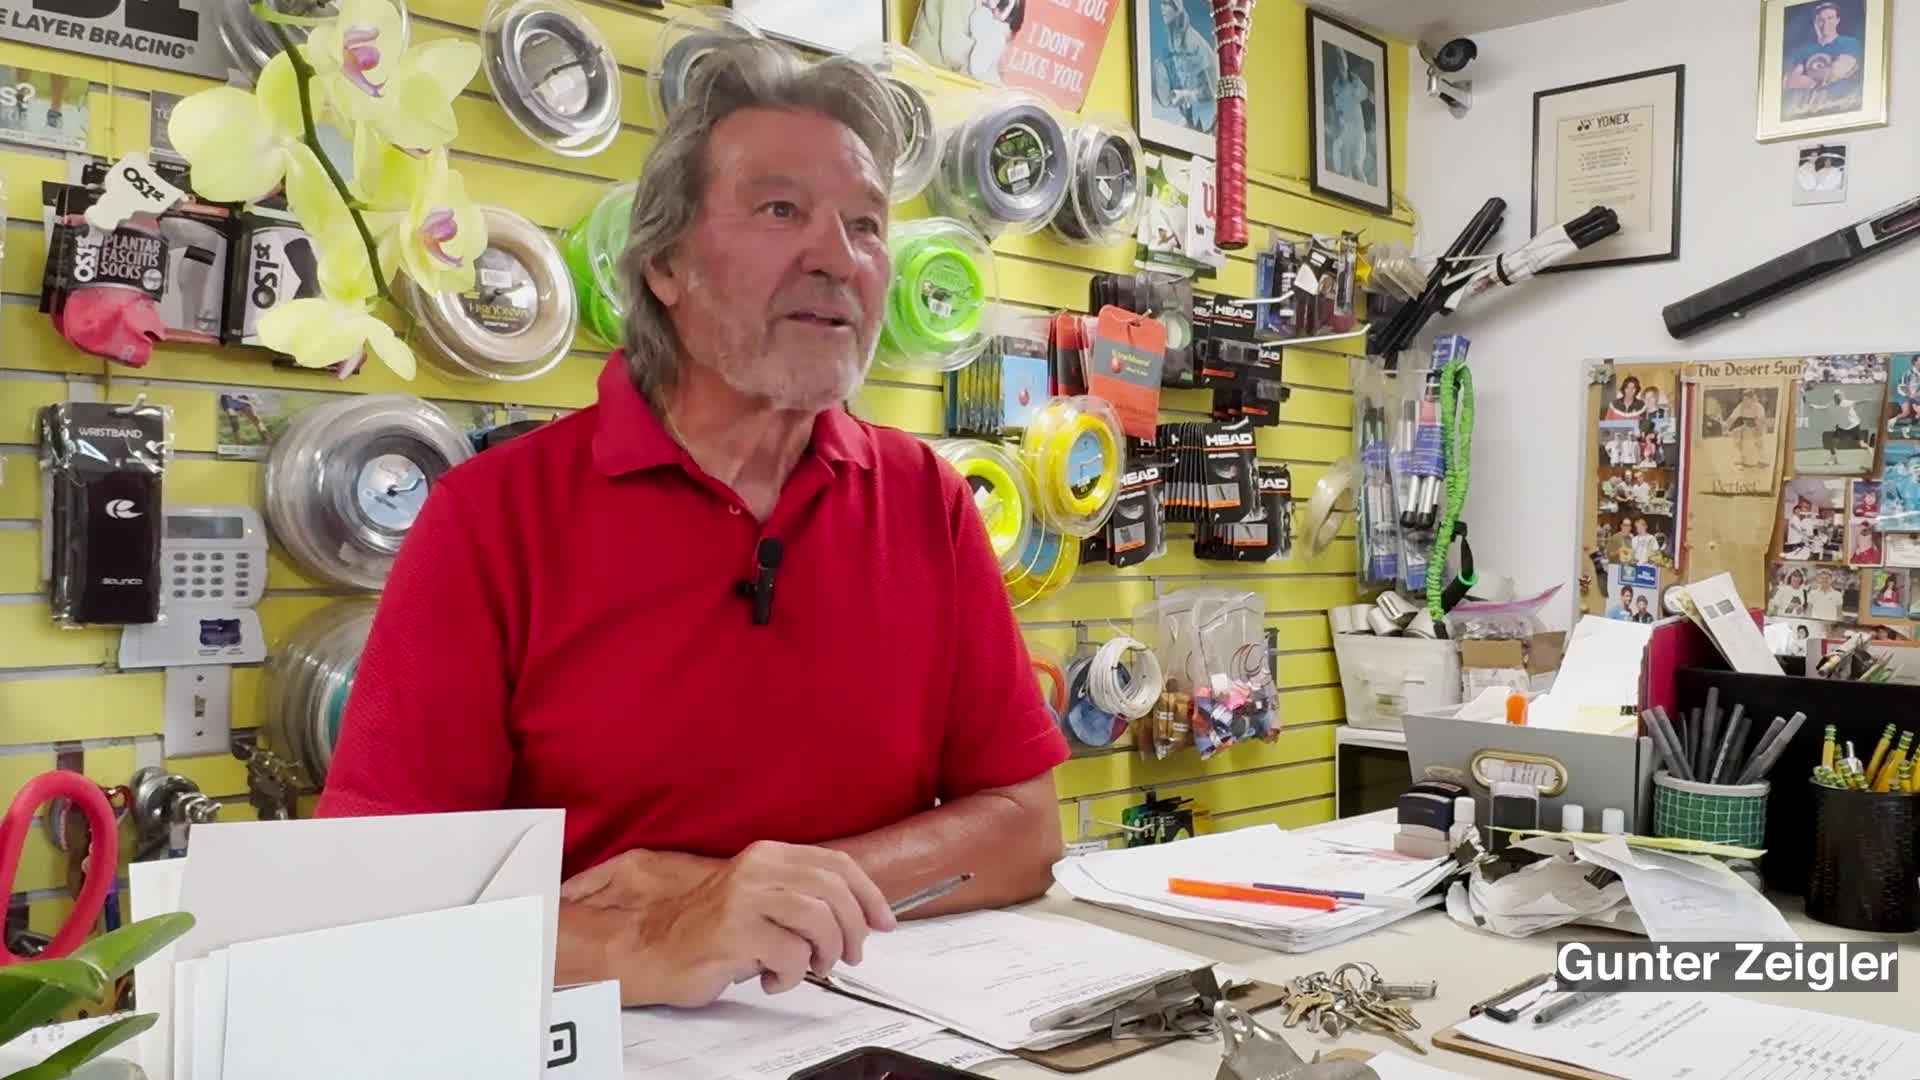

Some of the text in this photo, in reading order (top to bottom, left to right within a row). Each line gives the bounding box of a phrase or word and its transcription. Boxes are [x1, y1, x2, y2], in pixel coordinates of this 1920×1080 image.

[12, 11, 85, 40] LAYER
[1008, 47, 1049, 80] LIKE
[1596, 113, 1630, 128] YONEX
[103, 234, 160, 254] PLANTAR
[100, 261, 141, 280] SOCKS
[252, 242, 279, 309] OS1st
[1215, 305, 1253, 319] HEAD
[1699, 363, 1720, 377] The
[1725, 361, 1769, 376] Desert
[78, 427, 143, 439] WRISTBAND
[1205, 434, 1253, 446] HEAD
